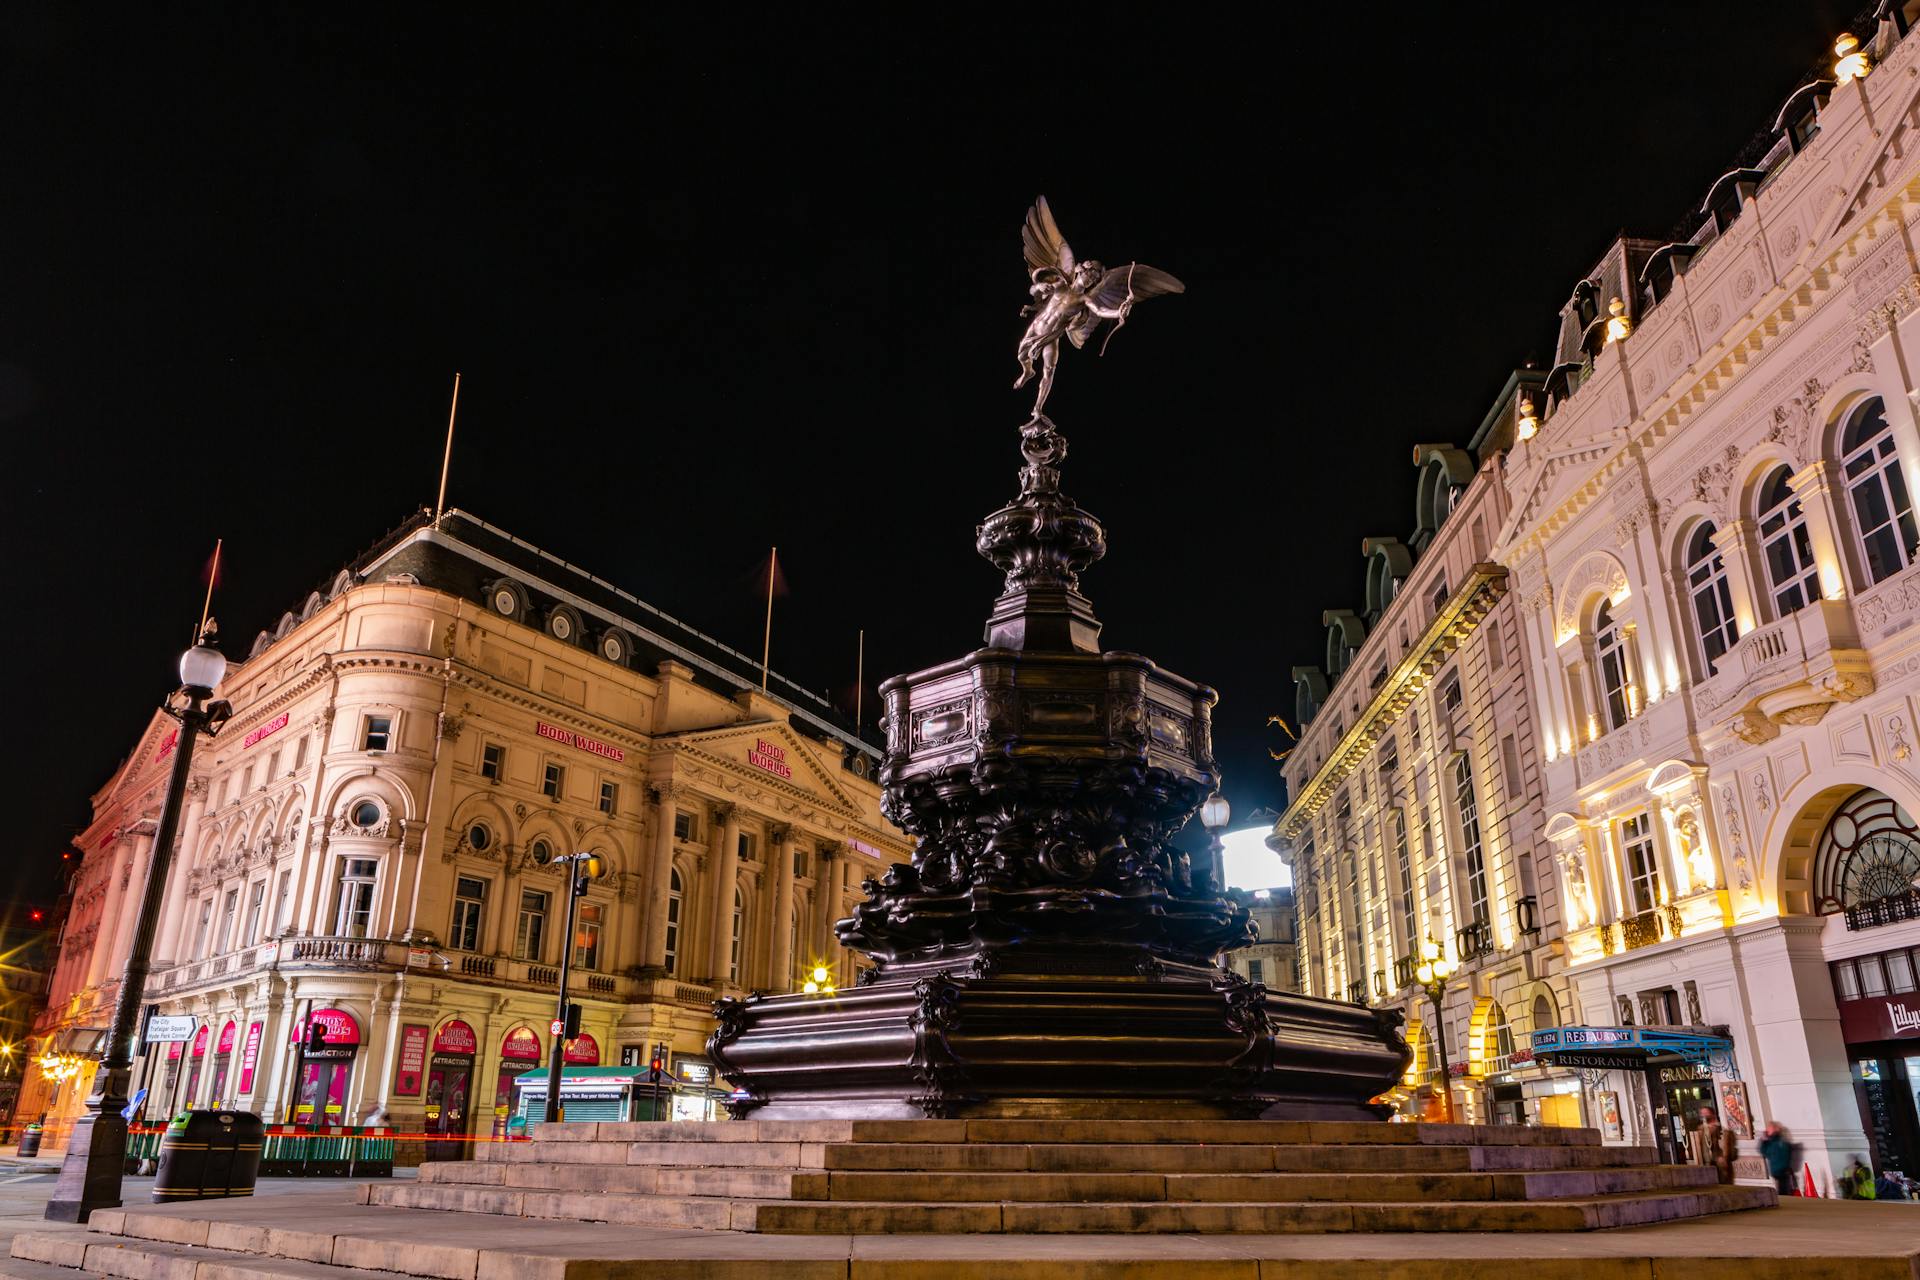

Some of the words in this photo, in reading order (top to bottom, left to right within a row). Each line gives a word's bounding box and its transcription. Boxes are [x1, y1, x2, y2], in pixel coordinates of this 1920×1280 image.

[538, 723, 574, 746] BODY
[576, 735, 625, 763] WORLDS
[758, 739, 786, 761] BODY
[749, 750, 792, 780] WORLDS
[552, 1022, 560, 1031] 20
[446, 1029, 468, 1038] BODY
[1565, 1031, 1629, 1043] RESTAURANT
[439, 1036, 472, 1047] WORLDS
[433, 1057, 470, 1065] ATTRACTION
[1559, 1055, 1644, 1068] RISTORANTE
